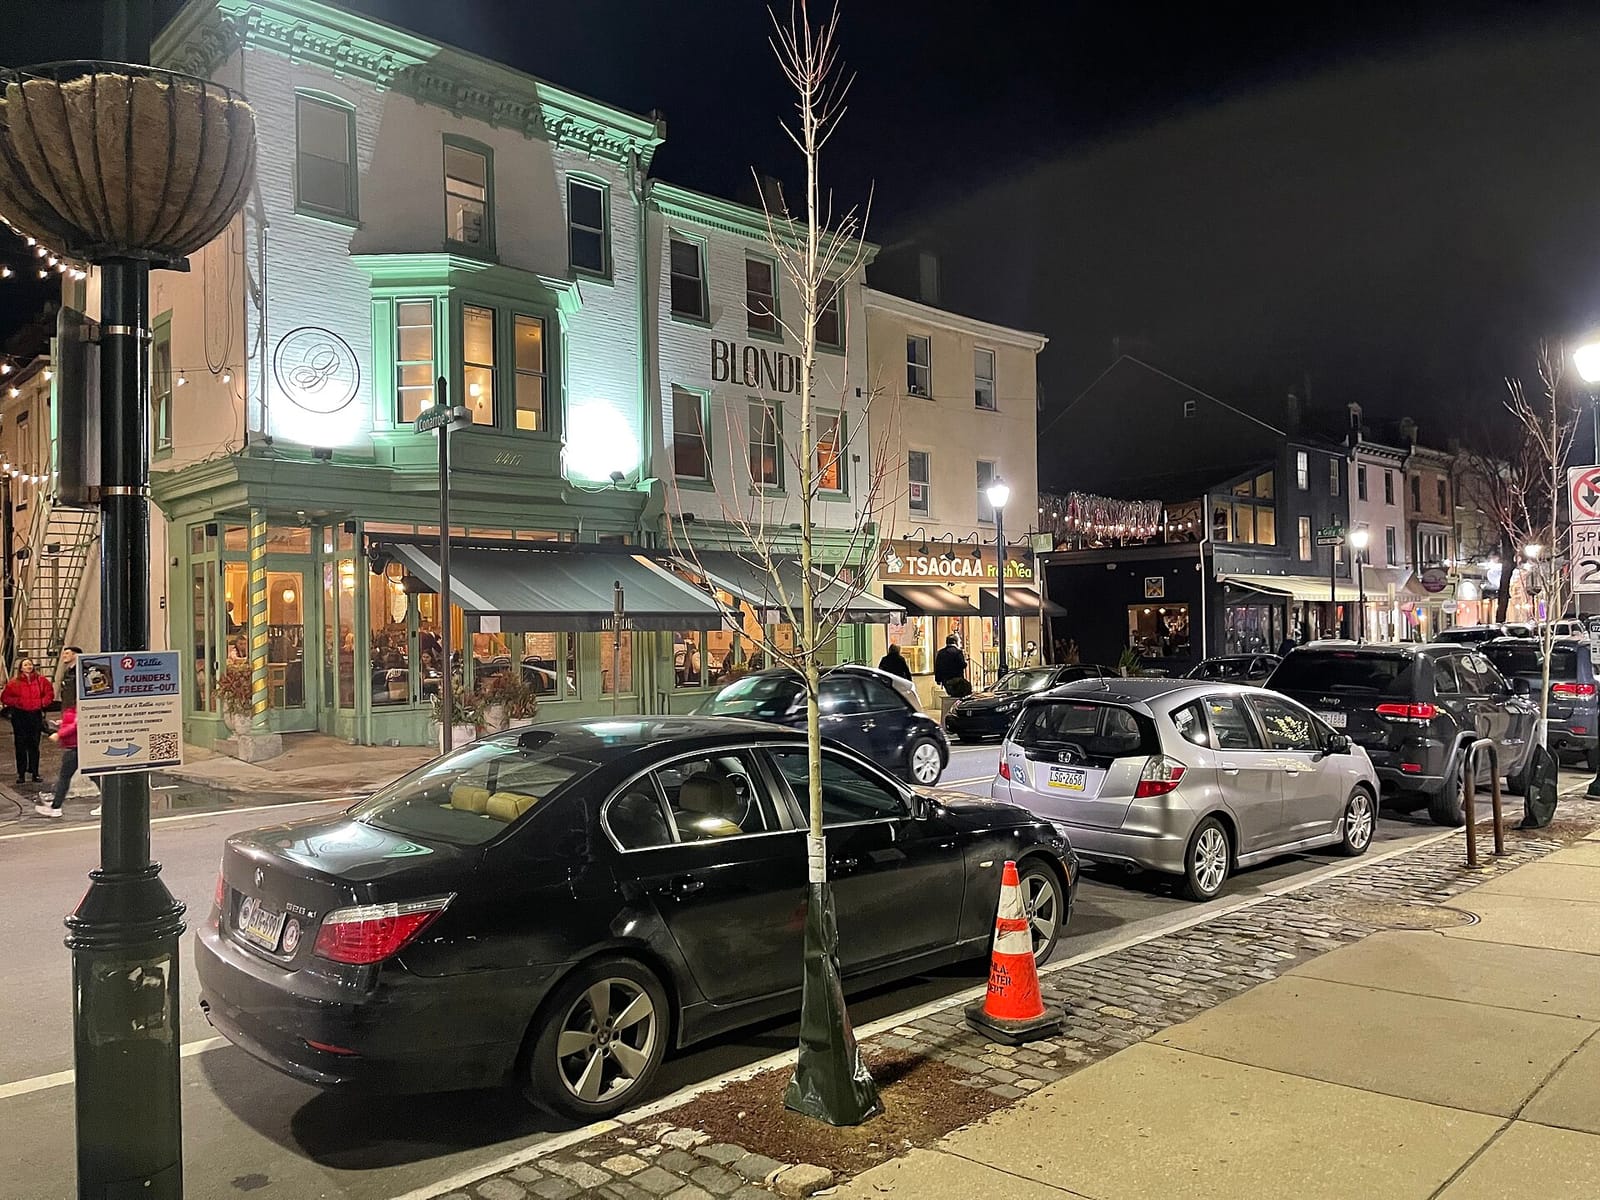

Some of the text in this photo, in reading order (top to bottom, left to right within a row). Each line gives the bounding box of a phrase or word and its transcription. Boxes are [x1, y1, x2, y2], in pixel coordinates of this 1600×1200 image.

[711, 339, 816, 398] BLONDI
[124, 673, 171, 683] FOUNDERS
[118, 683, 176, 694] FREEZE-OUT
[990, 972, 1012, 986] ATER
